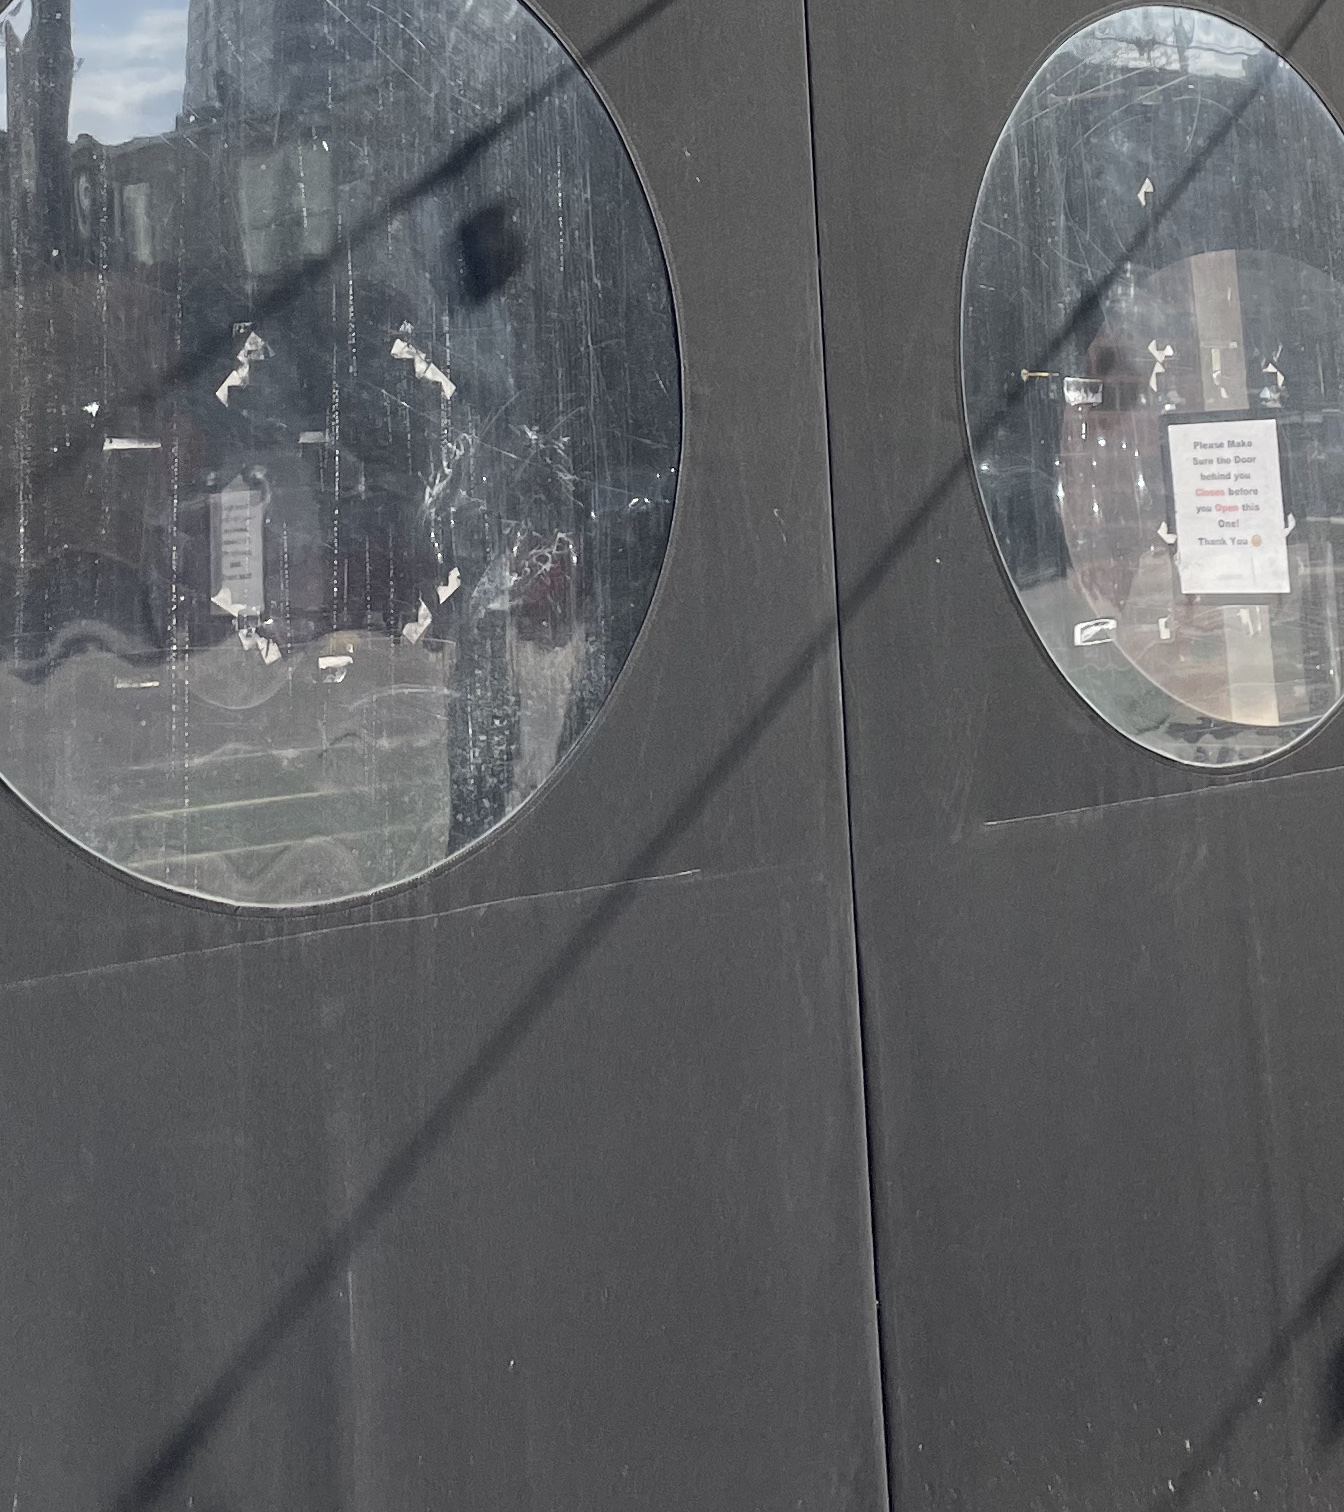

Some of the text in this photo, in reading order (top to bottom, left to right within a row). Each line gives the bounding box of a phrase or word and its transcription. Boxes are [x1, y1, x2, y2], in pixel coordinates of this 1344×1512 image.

[1193, 439, 1253, 450] Please Make
[1192, 455, 1257, 465] Sure the Door
[1200, 472, 1251, 481] behind you
[1228, 487, 1259, 496] before
[1196, 503, 1260, 513] you Open this
[1218, 519, 1240, 528] One!
[1198, 537, 1249, 546] Thank You
